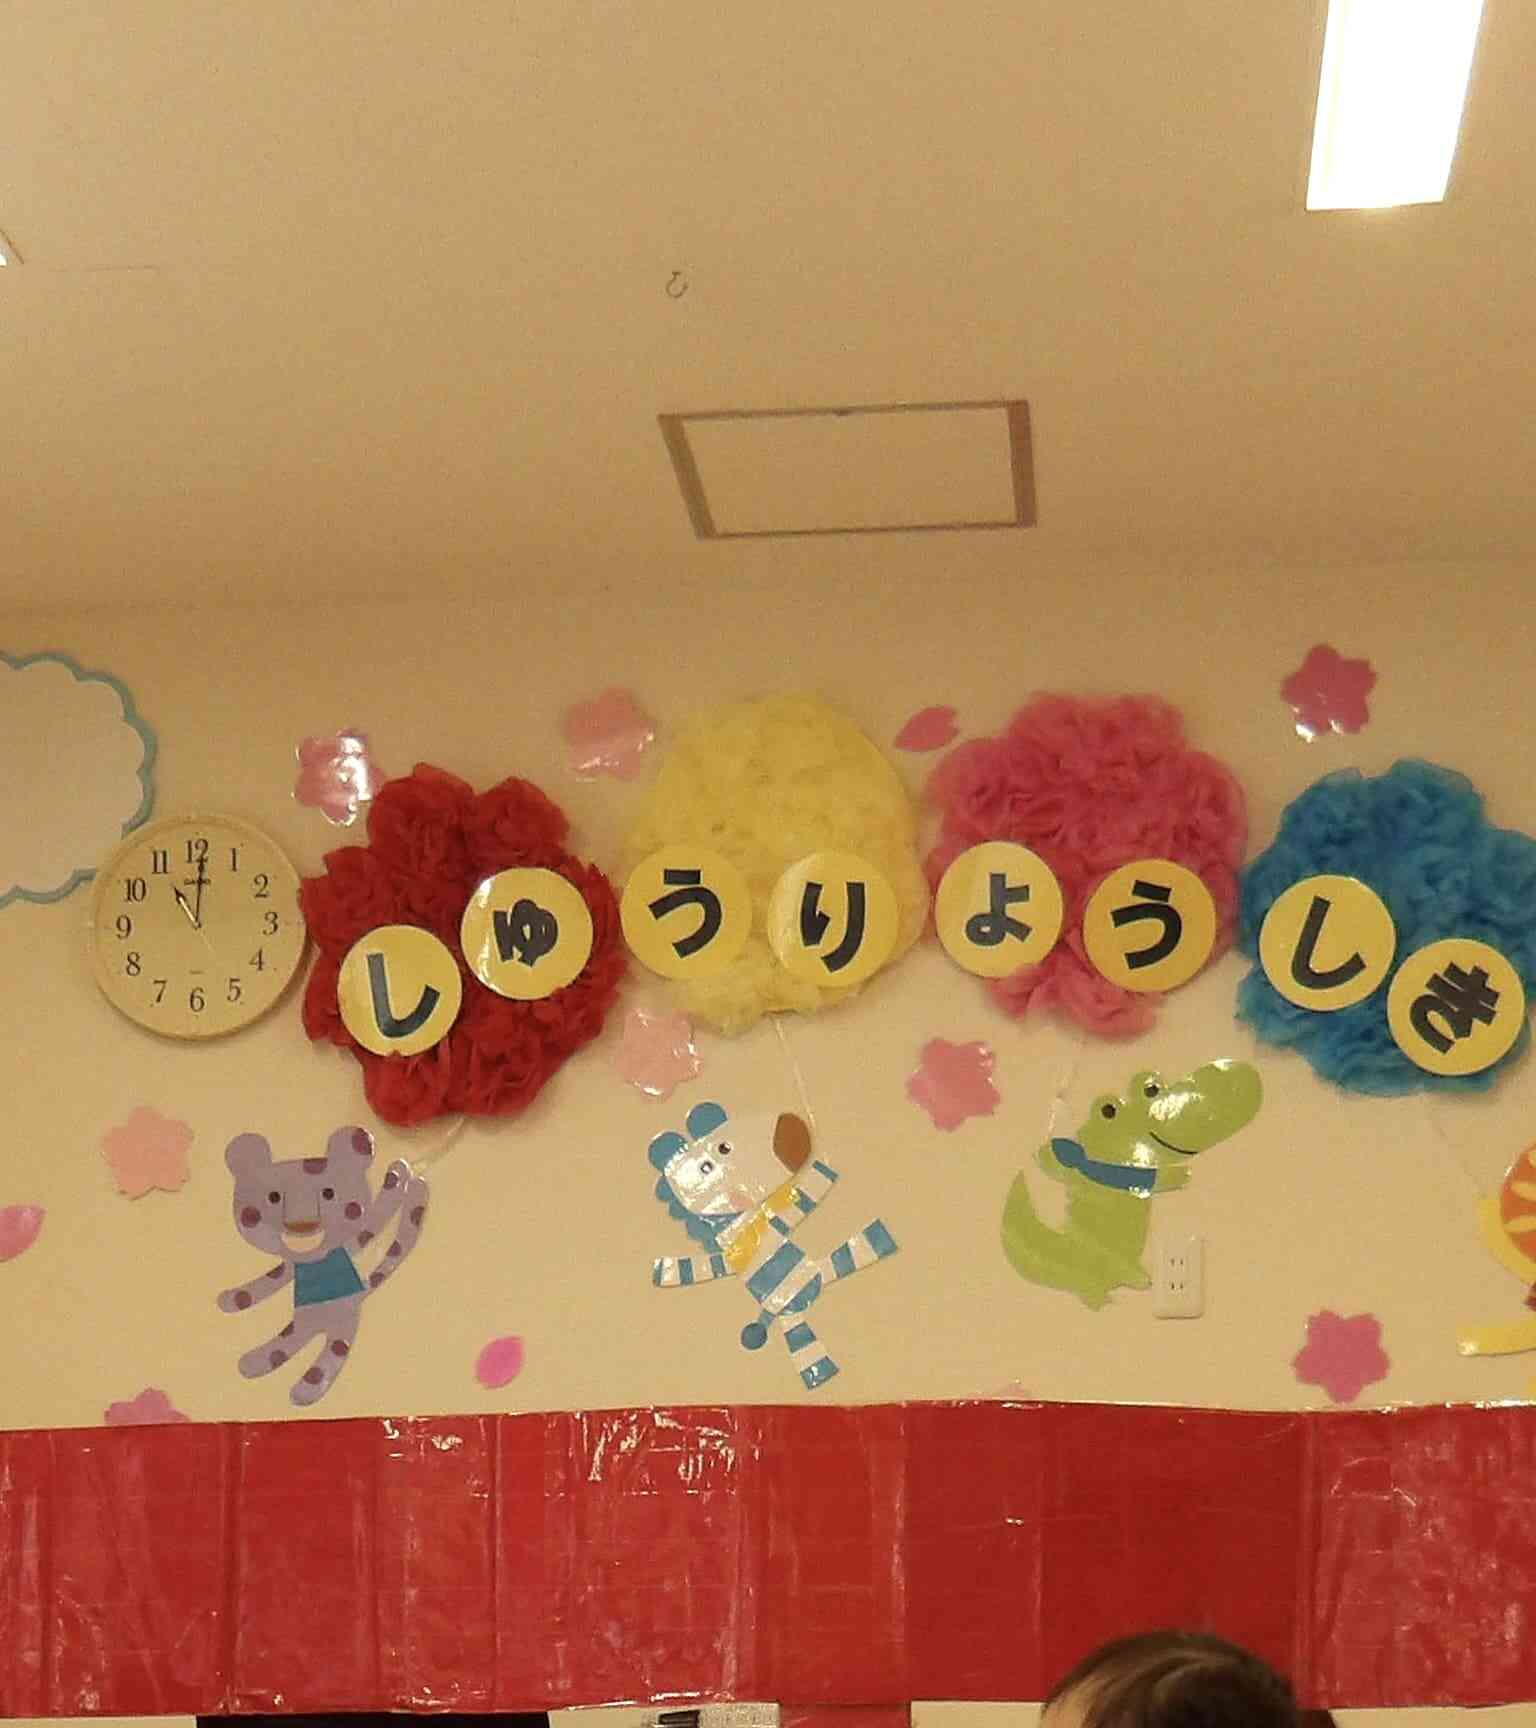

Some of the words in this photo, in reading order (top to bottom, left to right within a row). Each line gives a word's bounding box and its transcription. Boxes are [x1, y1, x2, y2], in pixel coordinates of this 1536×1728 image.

[151, 849, 168, 875] 11
[185, 838, 209, 864] 12
[230, 847, 238, 872] 1
[124, 877, 146, 902] 10
[253, 873, 270, 899] 2
[115, 914, 132, 940] 9
[262, 911, 279, 936] 3
[126, 951, 141, 976] 8
[249, 948, 265, 972] 4
[152, 979, 167, 1003] 7
[189, 986, 205, 1012] 6
[226, 977, 242, 1002] 5
